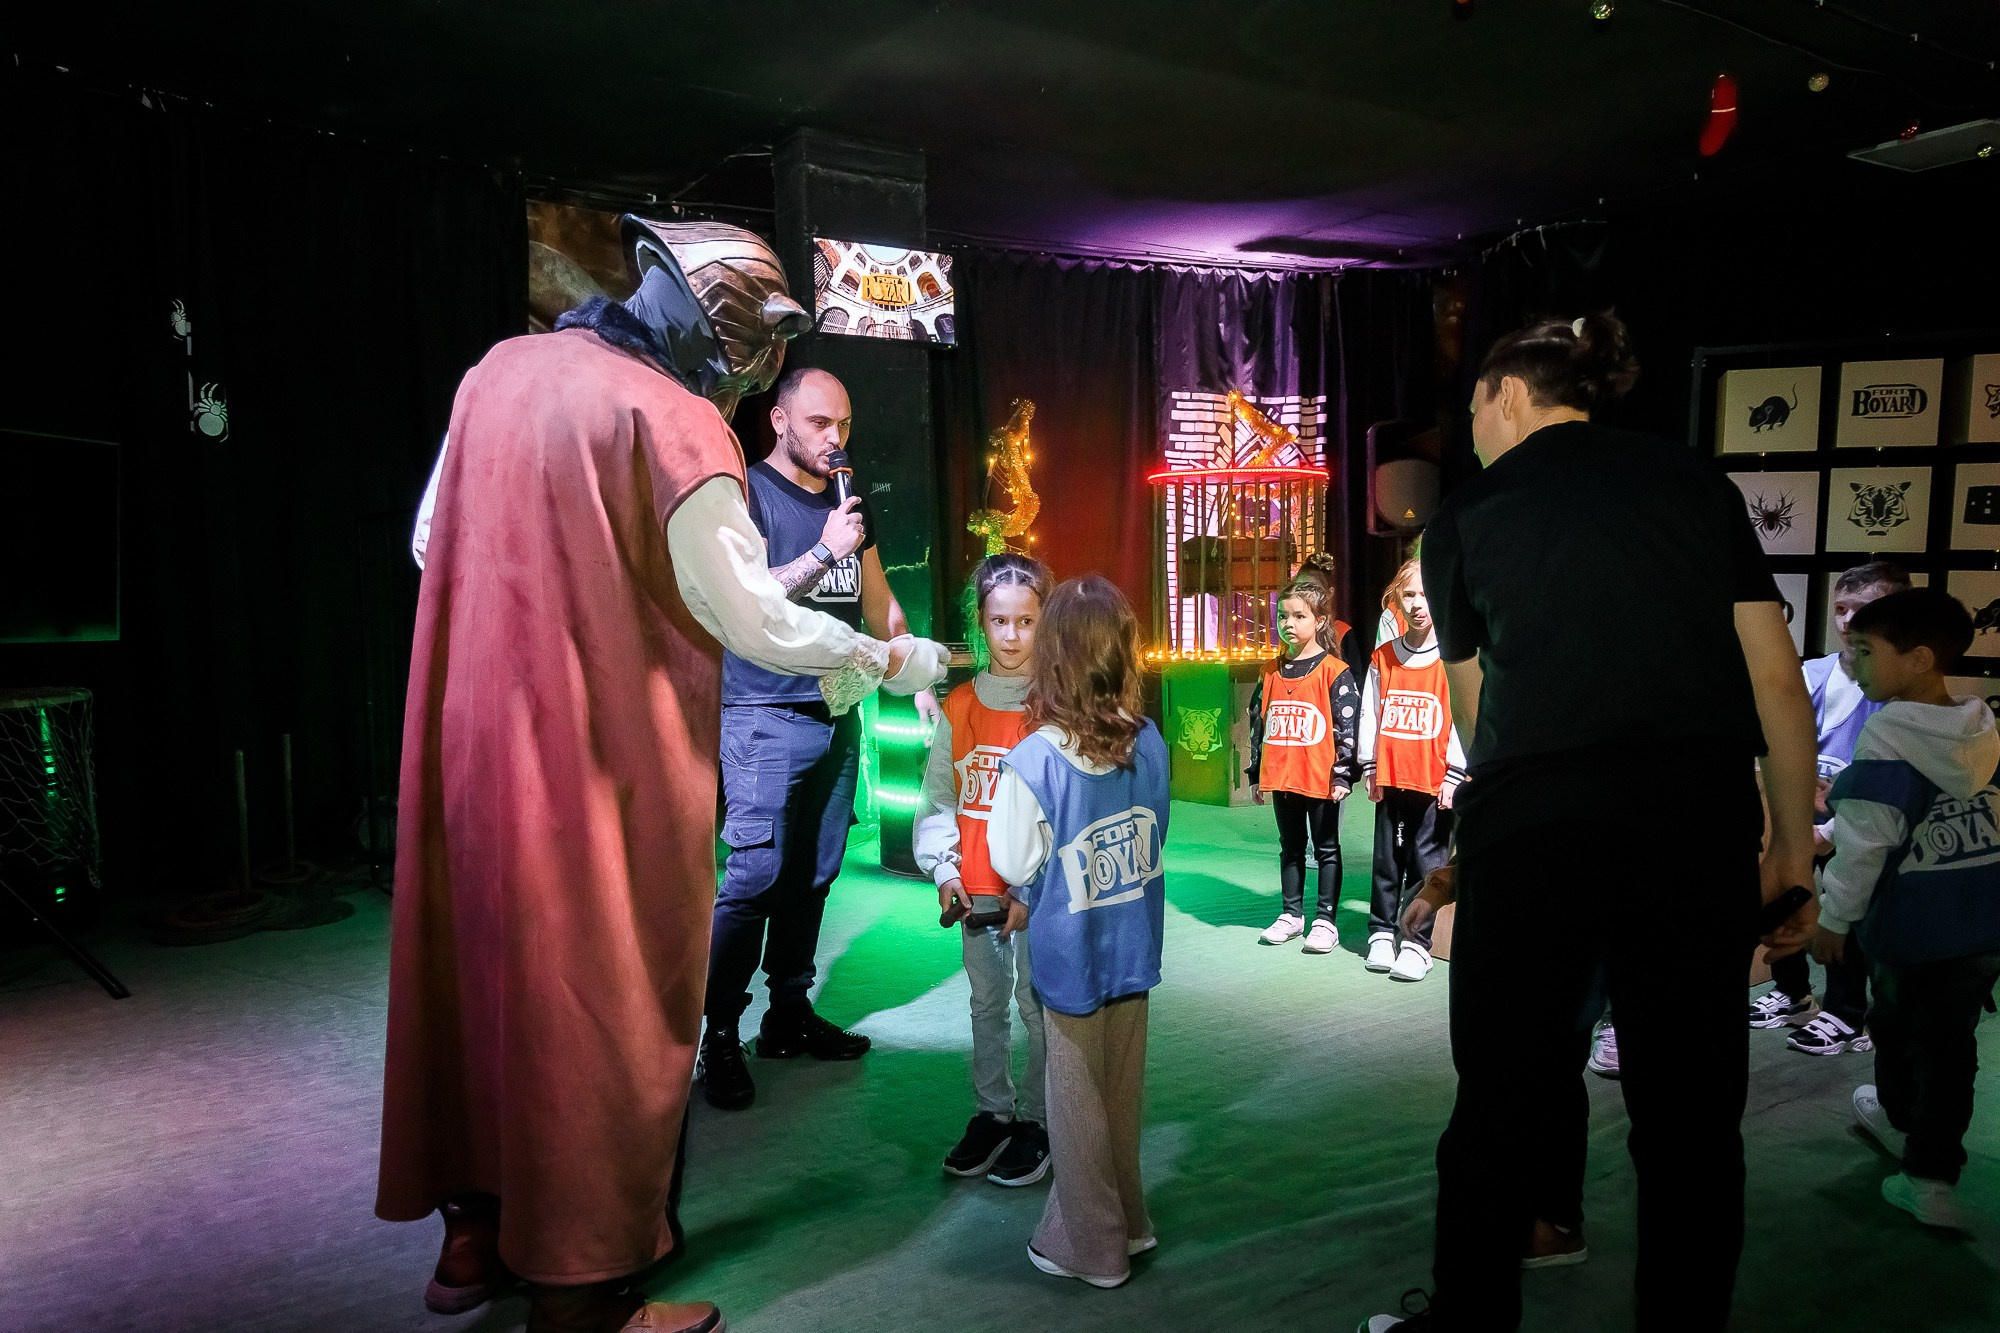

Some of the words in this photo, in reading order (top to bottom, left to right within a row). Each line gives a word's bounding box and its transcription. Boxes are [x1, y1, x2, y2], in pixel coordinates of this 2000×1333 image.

[1872, 388, 1905, 396] FORT
[1851, 388, 1928, 416] BOYARD
[1390, 695, 1425, 707] FORT
[1271, 706, 1306, 715] FORT
[1928, 796, 1985, 821] FOR
[1092, 821, 1135, 849] FOR
